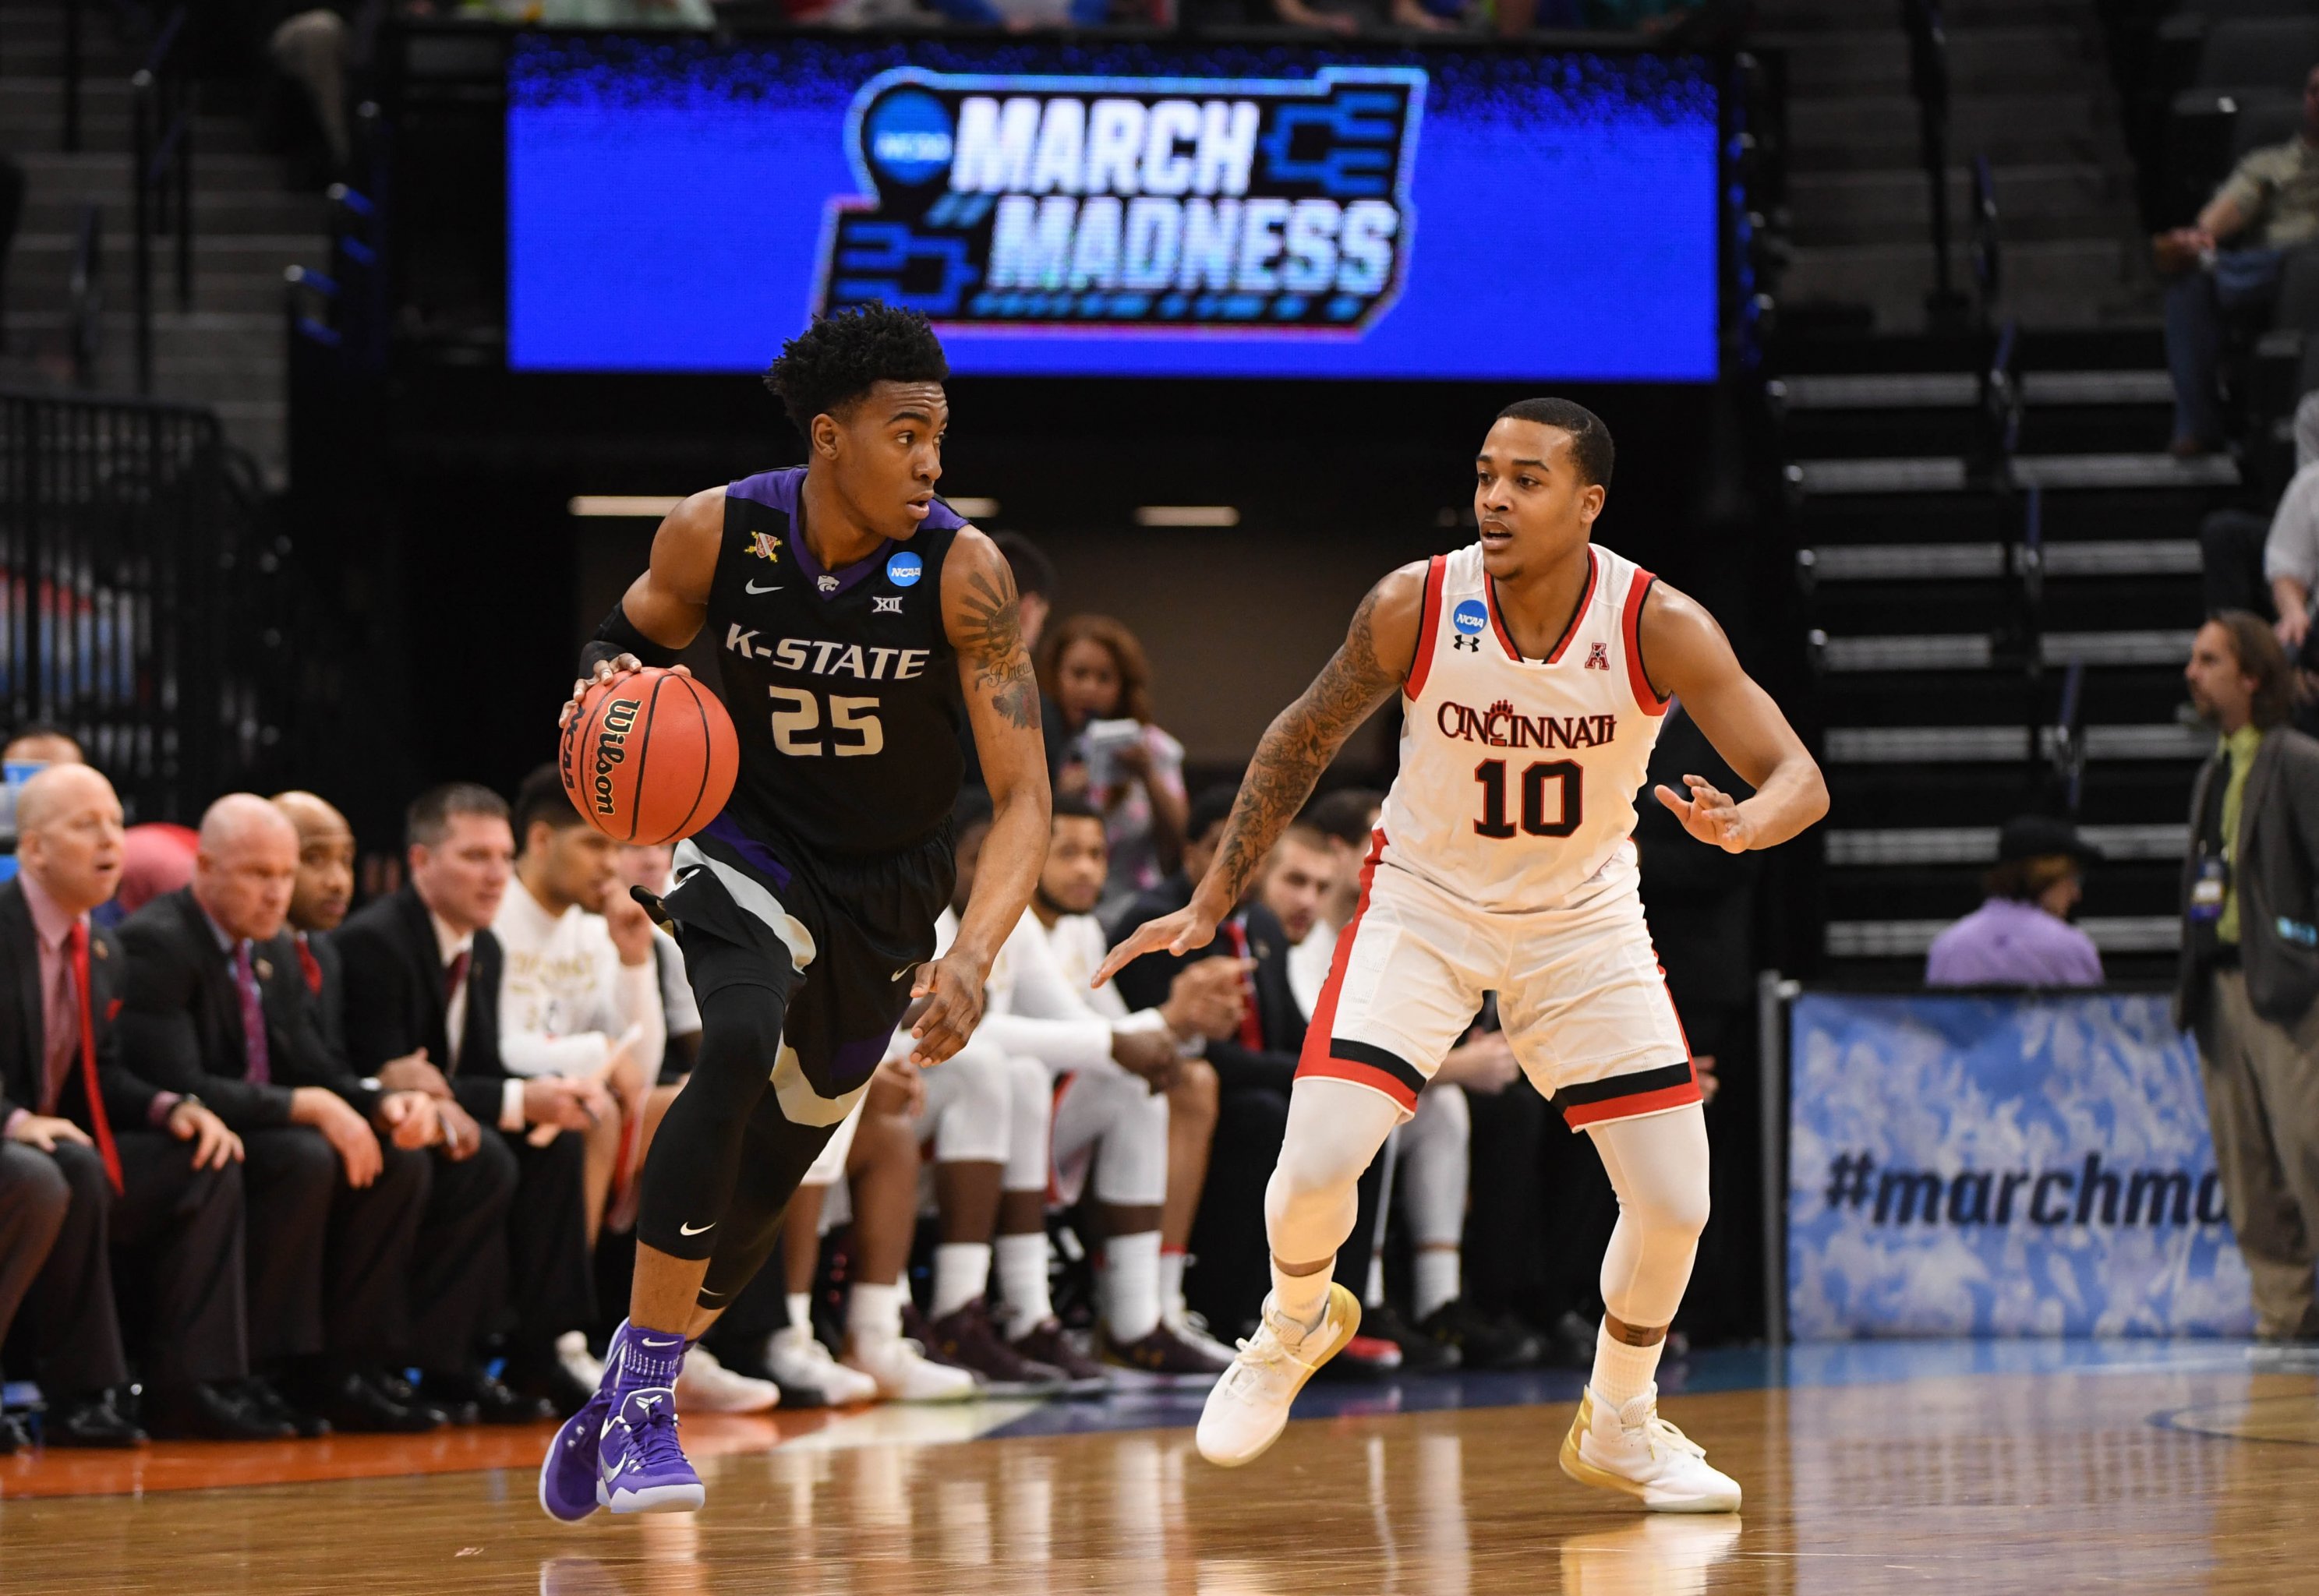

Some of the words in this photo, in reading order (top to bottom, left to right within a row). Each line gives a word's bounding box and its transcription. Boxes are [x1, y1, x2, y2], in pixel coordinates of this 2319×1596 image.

[948, 97, 1260, 196] MARCH
[986, 196, 1399, 295] MADNESS
[891, 567, 921, 577] NCAA
[726, 623, 930, 680] K-STATE
[1456, 613, 1484, 628] NCAA
[594, 698, 642, 816] Wilson
[769, 685, 884, 757] 25
[1473, 758, 1584, 839] 10
